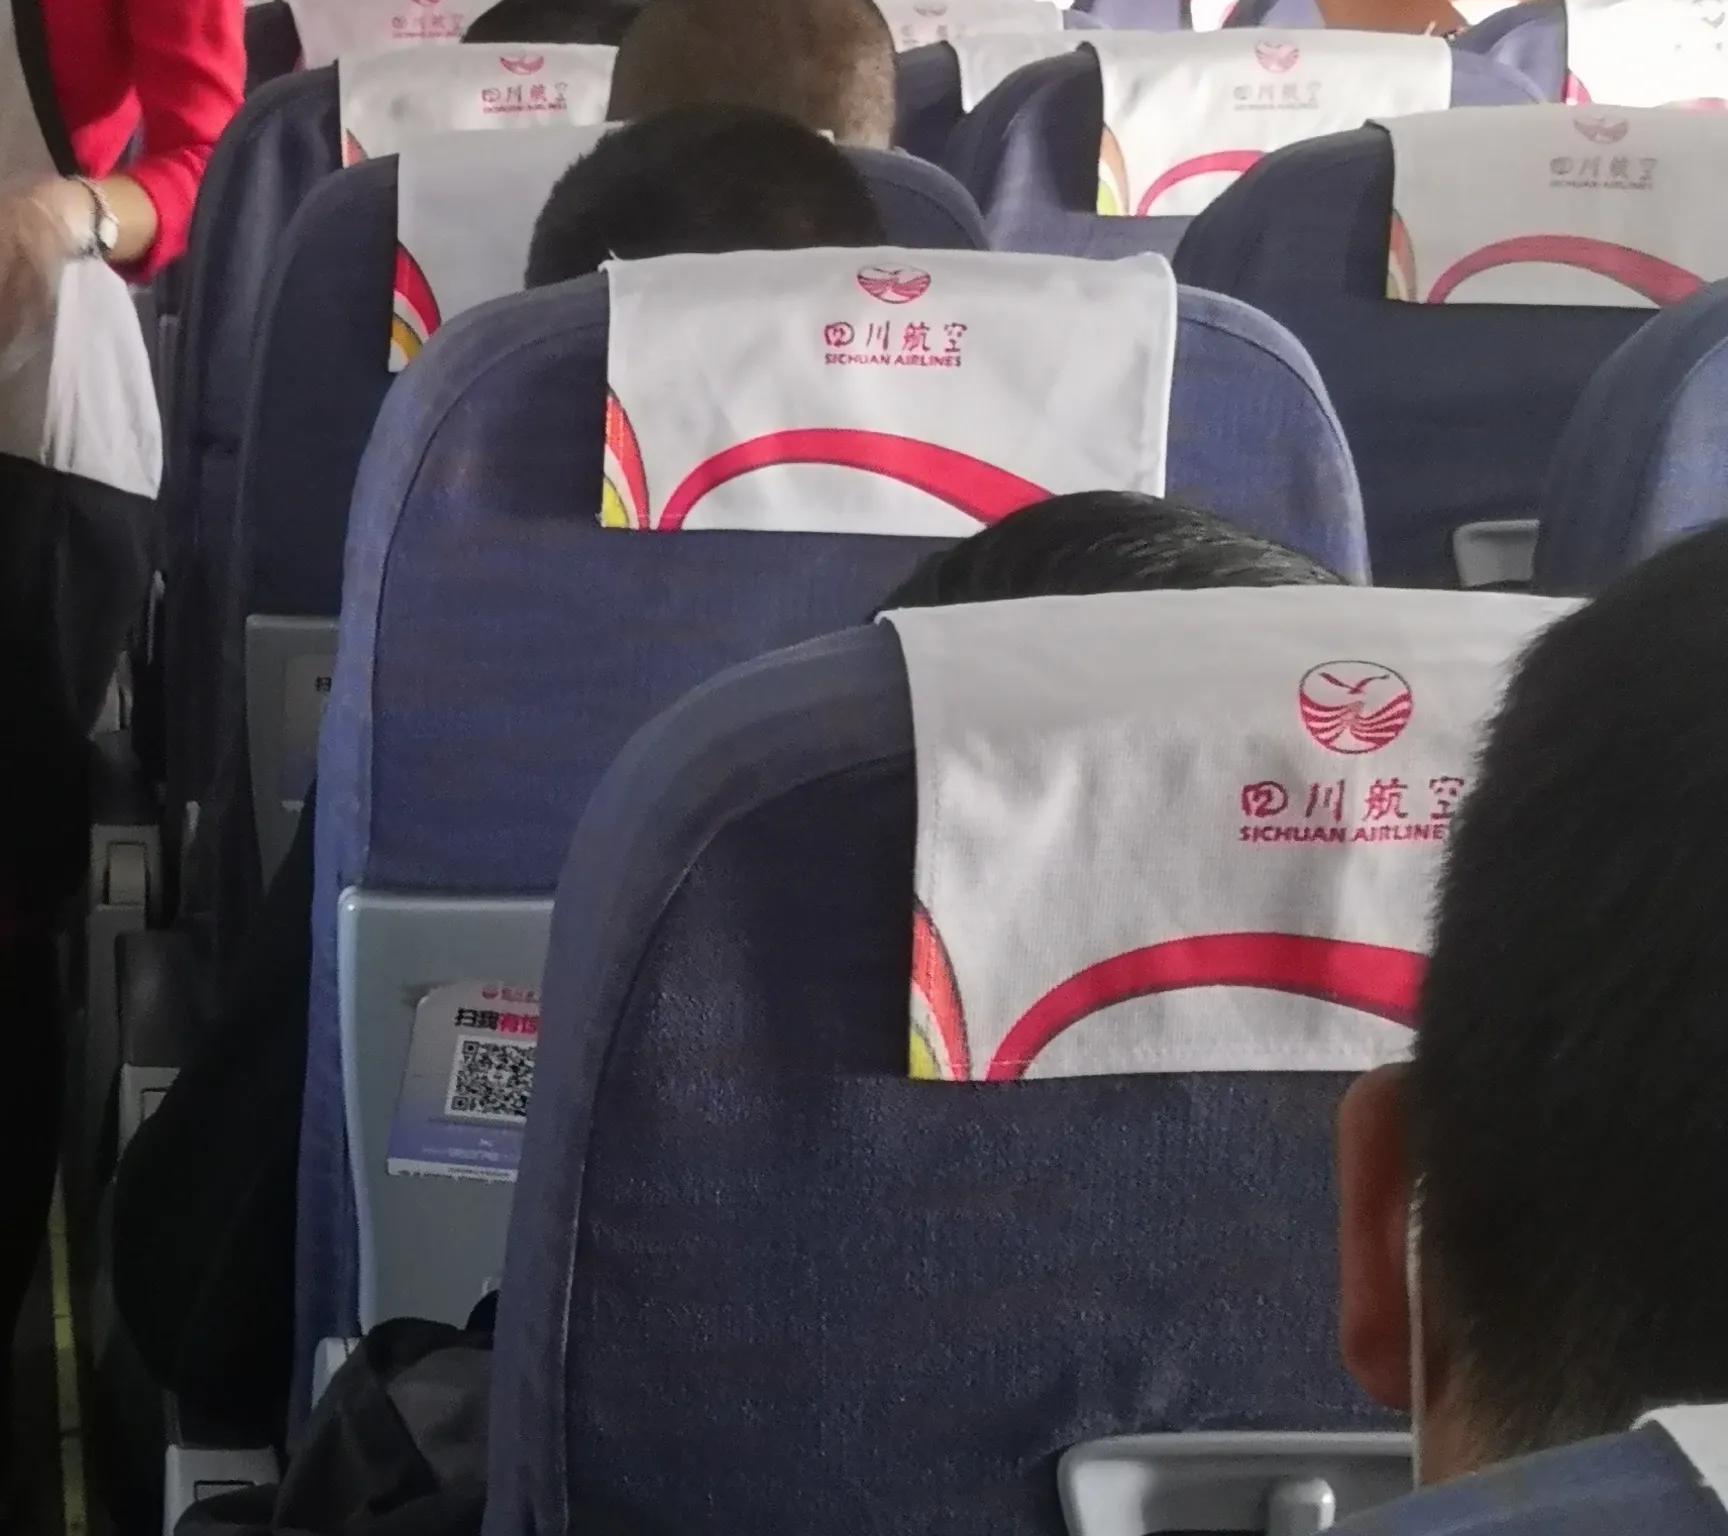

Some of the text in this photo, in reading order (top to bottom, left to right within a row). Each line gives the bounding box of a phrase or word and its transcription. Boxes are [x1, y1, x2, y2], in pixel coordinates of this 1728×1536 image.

[824, 321, 968, 353] 四川航空
[824, 353, 962, 367] SICHUAN AIRLINES
[1241, 776, 1465, 823] 四川航空
[1239, 824, 1448, 843] SICHUAN AIRLINE
